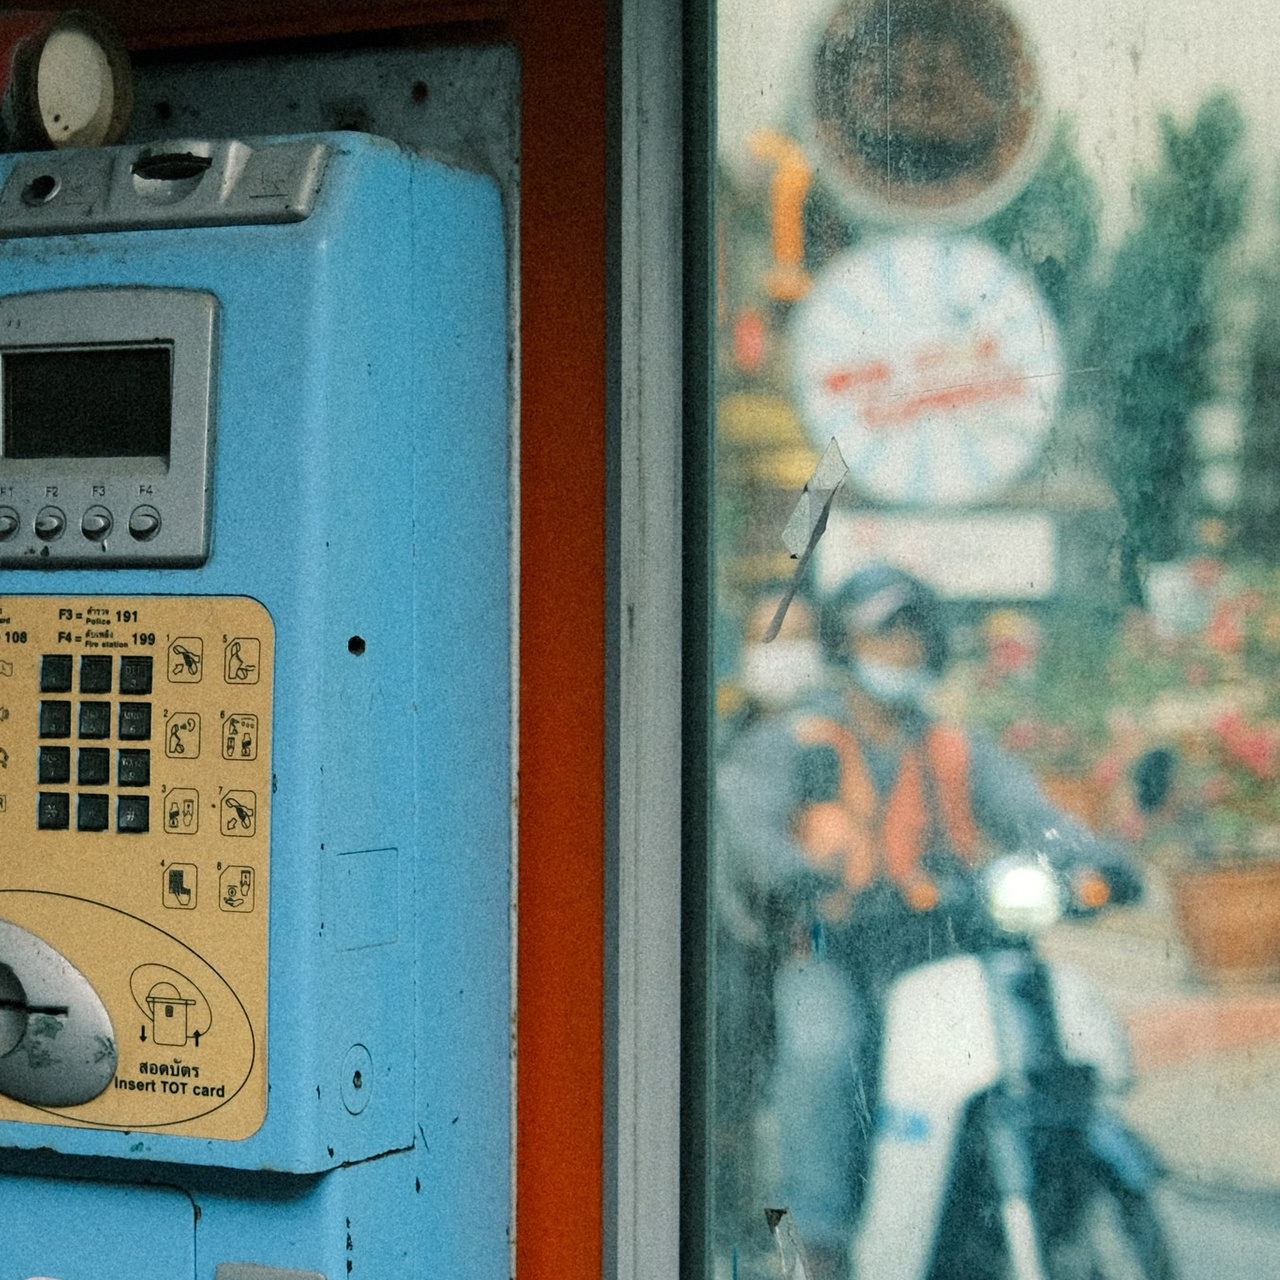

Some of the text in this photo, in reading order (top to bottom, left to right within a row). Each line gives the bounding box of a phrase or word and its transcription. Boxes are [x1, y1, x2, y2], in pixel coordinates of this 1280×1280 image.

[0, 487, 13, 497] F1
[45, 486, 58, 497] F2
[92, 485, 106, 496] F3
[139, 485, 153, 495] F4
[59, 608, 73, 620] F3
[115, 610, 138, 622] 191
[85, 617, 111, 625] Police
[5, 631, 28, 643] 108
[58, 631, 72, 643] F4
[132, 633, 156, 645] 199
[222, 634, 228, 643] 5
[163, 709, 169, 718] 2
[139, 1058, 199, 1078] สอดบัตร
[114, 1076, 225, 1098] Insert TOT card
